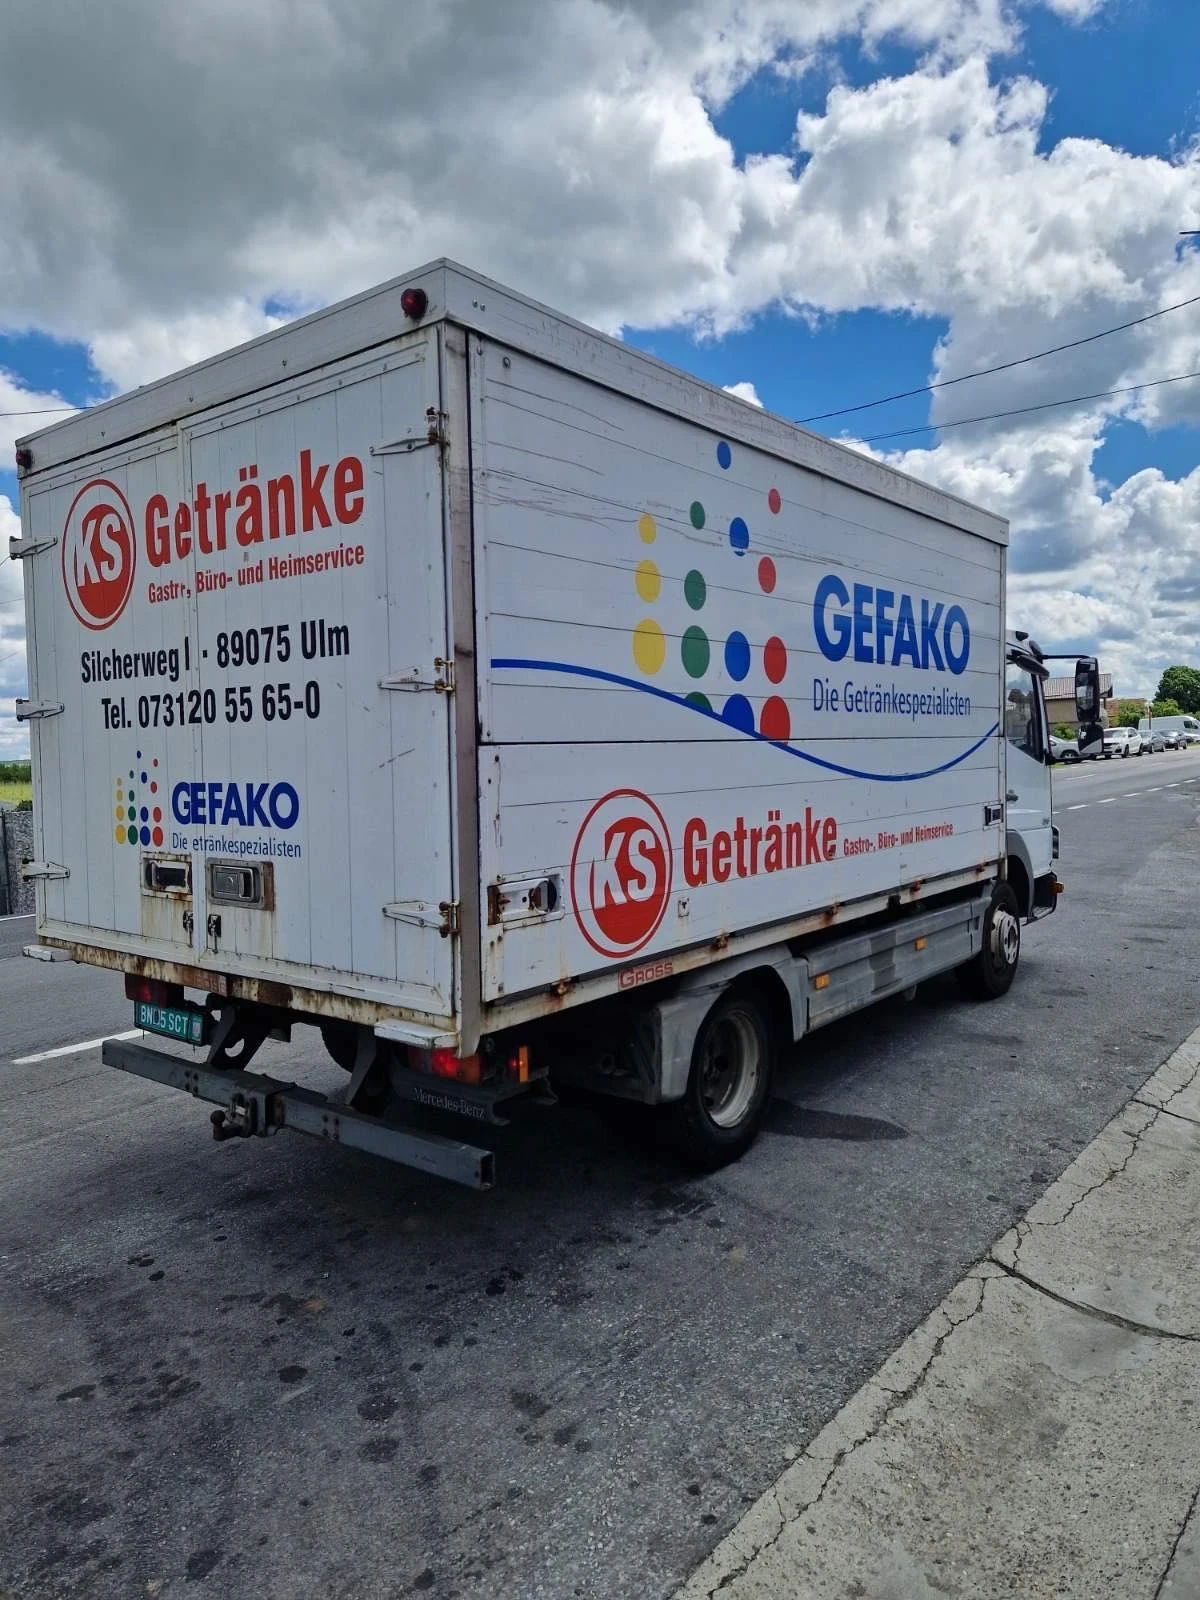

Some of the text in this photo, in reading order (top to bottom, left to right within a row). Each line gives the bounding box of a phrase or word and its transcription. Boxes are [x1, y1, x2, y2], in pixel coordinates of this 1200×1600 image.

[145, 449, 364, 567] Getränke
[77, 512, 123, 588] KS
[196, 571, 233, 593] Büro-
[238, 560, 263, 586] und
[269, 543, 365, 580] Heimservice
[813, 574, 971, 676] GEFAKO
[81, 648, 180, 683] Silcherweg
[216, 624, 291, 668] 89075
[300, 619, 350, 660] Ulm
[101, 697, 132, 729] Tel.
[225, 686, 252, 723] 55
[262, 680, 321, 721] 65-0
[813, 678, 971, 722] Die Getränkespezialisten
[171, 781, 300, 830] GEFAKO
[172, 832, 188, 850] Die
[683, 806, 954, 888] Getränke Gastro-, Büro- und Heimservice
[593, 828, 657, 909] KS
[168, 1012, 189, 1035] SCT
[413, 1087, 485, 1119] Mercedes-Benz
